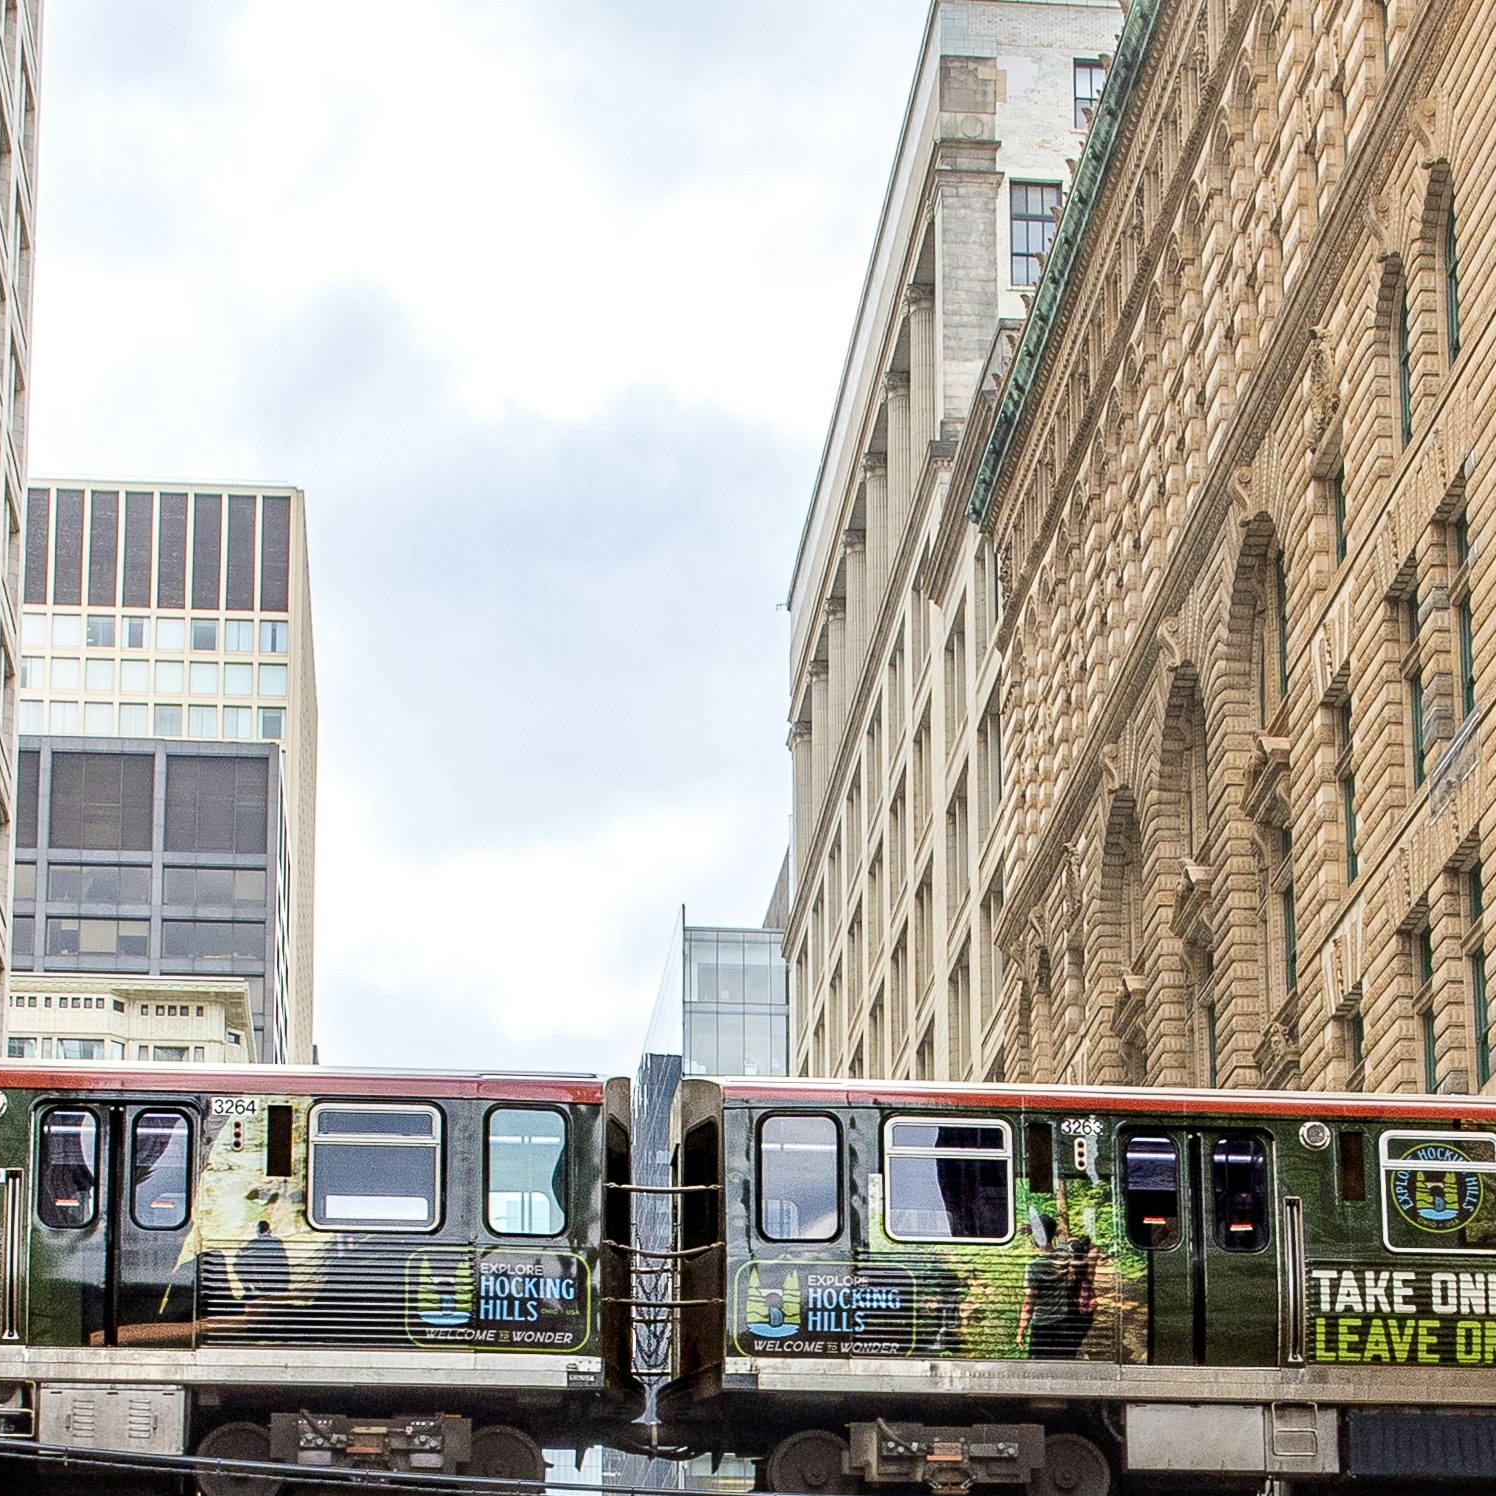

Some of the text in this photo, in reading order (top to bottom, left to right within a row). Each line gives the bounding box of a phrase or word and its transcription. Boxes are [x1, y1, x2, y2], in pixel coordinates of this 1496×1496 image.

[214, 1099, 256, 1115] 3264
[1062, 1119, 1104, 1135] 3263
[1462, 1177, 1479, 1212] HILLS
[480, 1263, 544, 1276] EXPLORE
[480, 1276, 575, 1300] HOCKING
[807, 1275, 870, 1287] EXPLORE
[1312, 1270, 1416, 1314] TAKE
[807, 1288, 902, 1310] HOCKING
[480, 1299, 538, 1322] HILLS
[807, 1311, 866, 1333] HILLS
[426, 1328, 497, 1341] WELCOME
[512, 1330, 573, 1344] WONDER
[754, 1340, 825, 1353] WELCOME
[840, 1342, 900, 1354] WONDER
[1315, 1318, 1440, 1363] LEAVE
